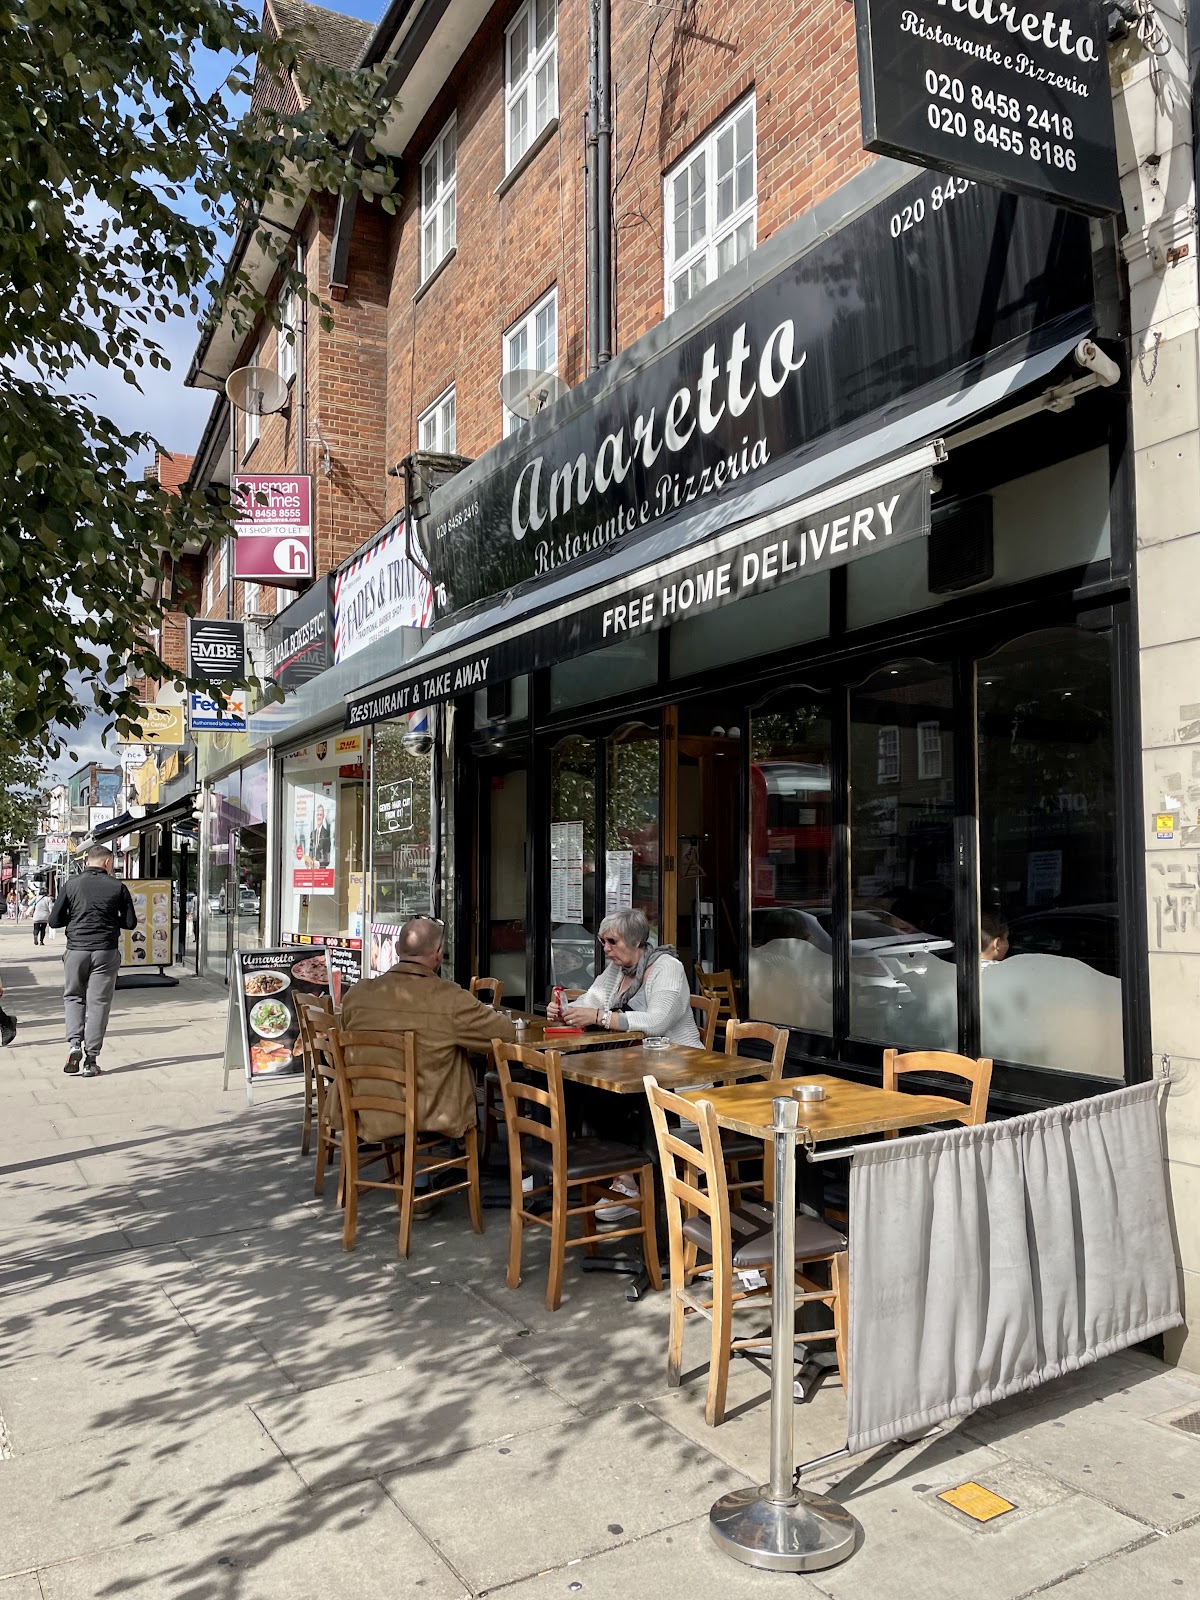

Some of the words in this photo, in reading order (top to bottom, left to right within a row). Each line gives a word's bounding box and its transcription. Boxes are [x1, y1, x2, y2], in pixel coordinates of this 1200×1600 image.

[900, 10, 1001, 65] Ristorante
[1003, 55, 1014, 69] e
[1015, 53, 1090, 97] Pizzeria
[925, 69, 964, 104] 020
[971, 85, 1021, 123] 8458
[1025, 104, 1075, 141] 2418
[927, 103, 967, 138] 020
[973, 118, 1024, 156] 8455
[1029, 137, 1077, 173] 8186
[890, 198, 925, 239] 020
[931, 176, 977, 211] 845
[511, 318, 807, 543] Amaretto
[251, 490, 301, 508] hlmes
[255, 509, 277, 518] 8458
[279, 509, 301, 517] 8555
[436, 524, 447, 540] 020
[448, 514, 463, 534] 8458
[464, 500, 480, 523] 2418
[533, 508, 637, 576] Ristorante
[639, 504, 651, 525] e
[655, 437, 771, 517] Pizzeria
[289, 545, 305, 570] h
[602, 593, 655, 638] FREE
[662, 563, 731, 617] HOME
[742, 494, 901, 588] DELIVERY
[346, 575, 376, 644] FADES
[378, 568, 385, 608] &
[434, 583, 447, 609] 76
[198, 643, 237, 659] MBE
[273, 642, 289, 665] MAIL
[289, 622, 308, 656] BOXES
[350, 692, 411, 724] RESTAURANT
[412, 686, 421, 703] &
[423, 678, 451, 701] TAKE
[454, 657, 490, 690] AWAY
[379, 802, 391, 812] GENTS
[392, 800, 402, 810] HAIR
[402, 798, 411, 807] CUT
[242, 954, 296, 965] Amaretto
